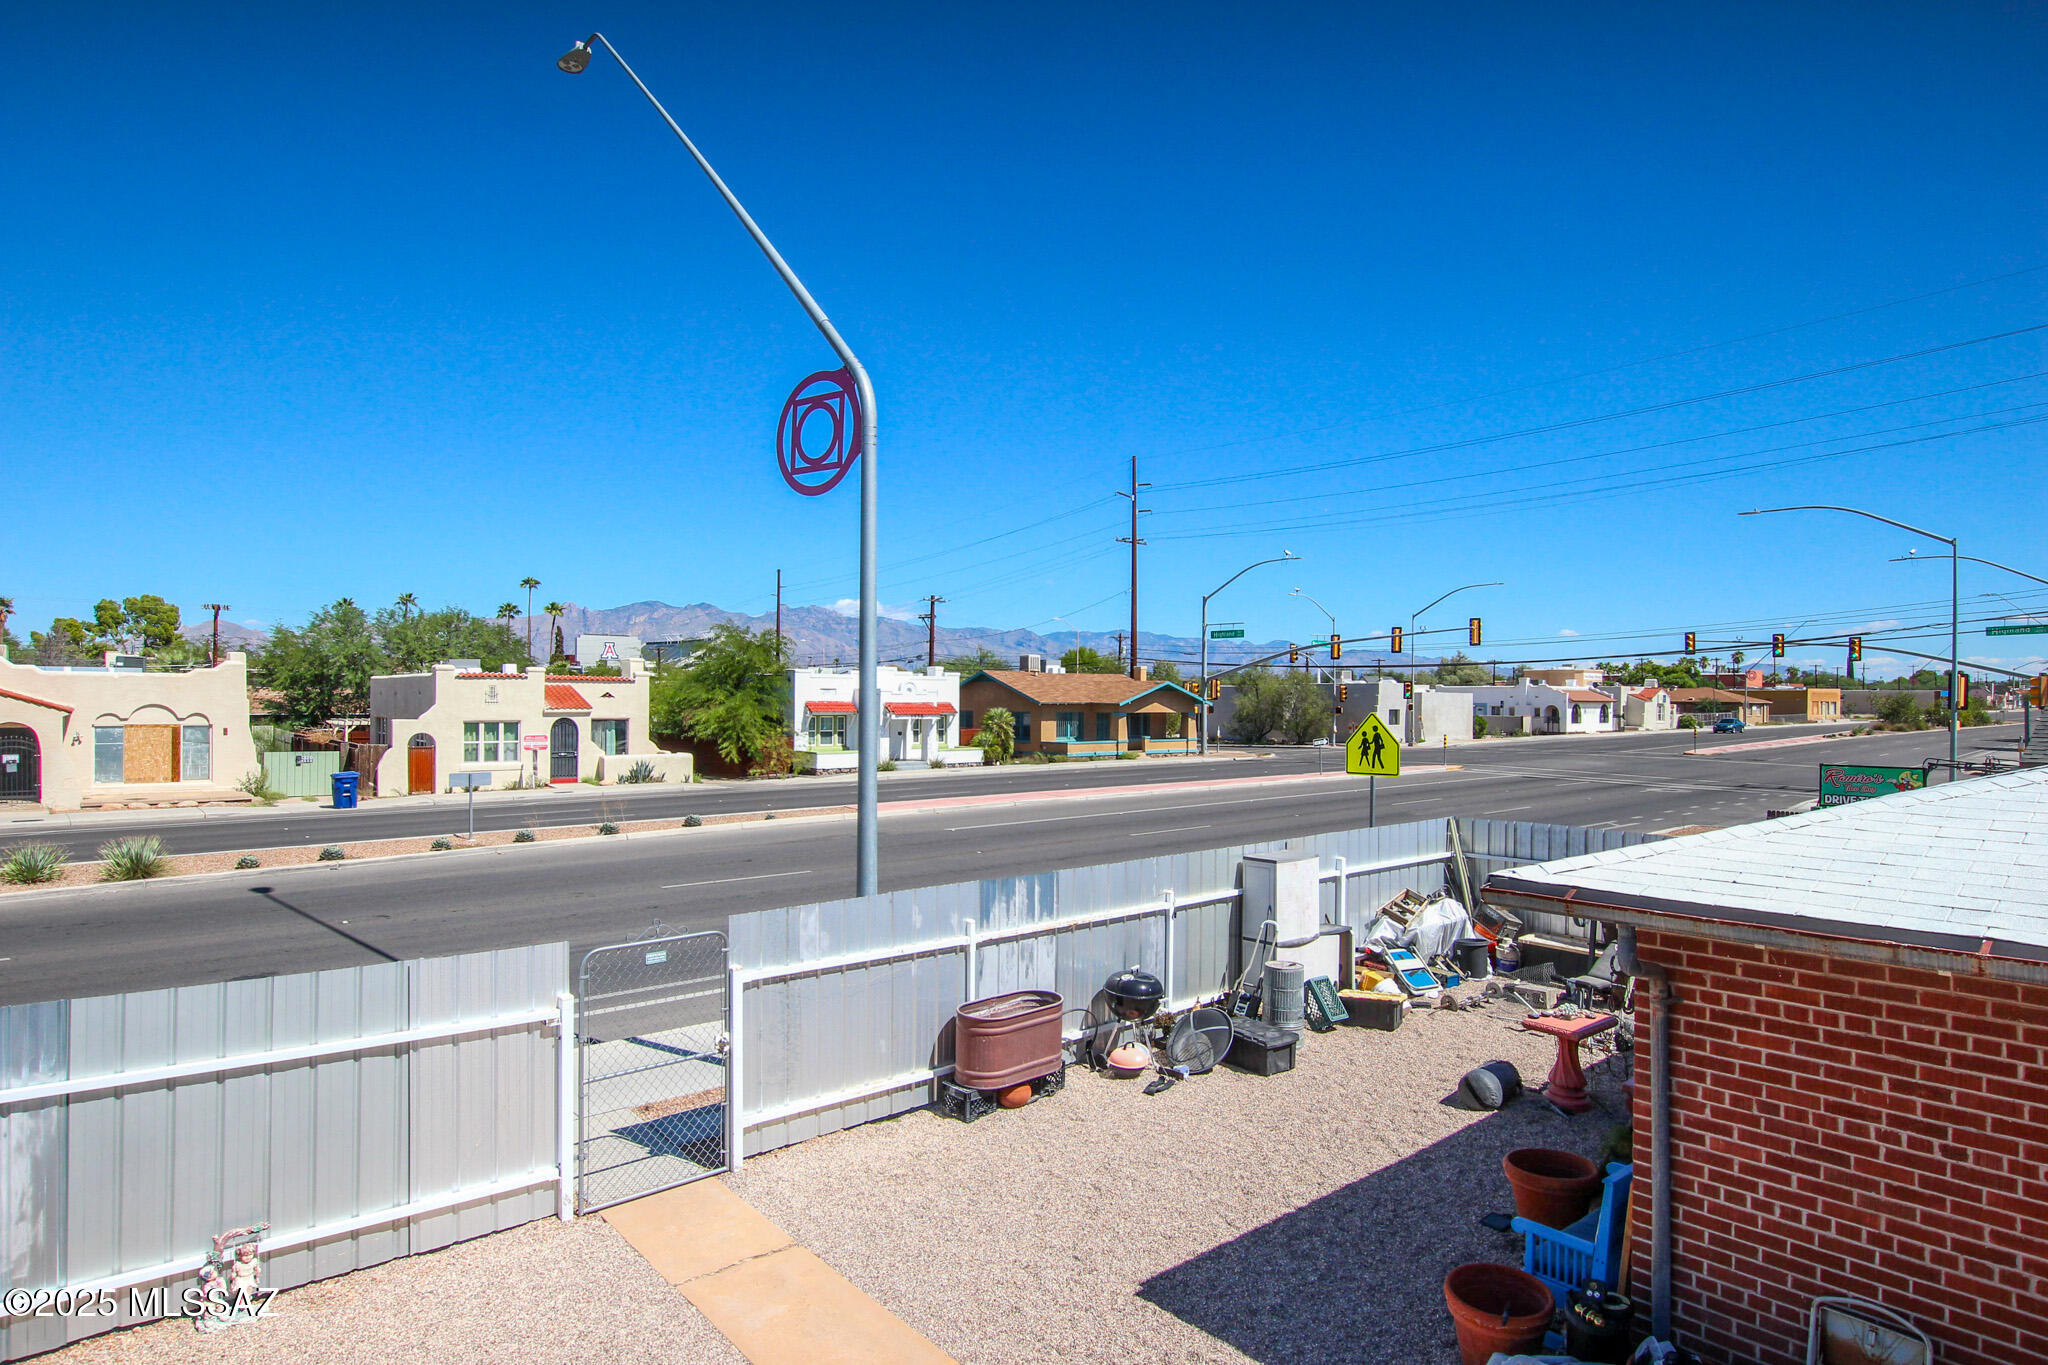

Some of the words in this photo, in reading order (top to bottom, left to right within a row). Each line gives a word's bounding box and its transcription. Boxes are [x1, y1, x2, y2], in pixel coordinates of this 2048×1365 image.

[601, 642, 619, 659] A
[1824, 768, 1884, 787] Ramiro's
[1845, 783, 1859, 793] Taco
